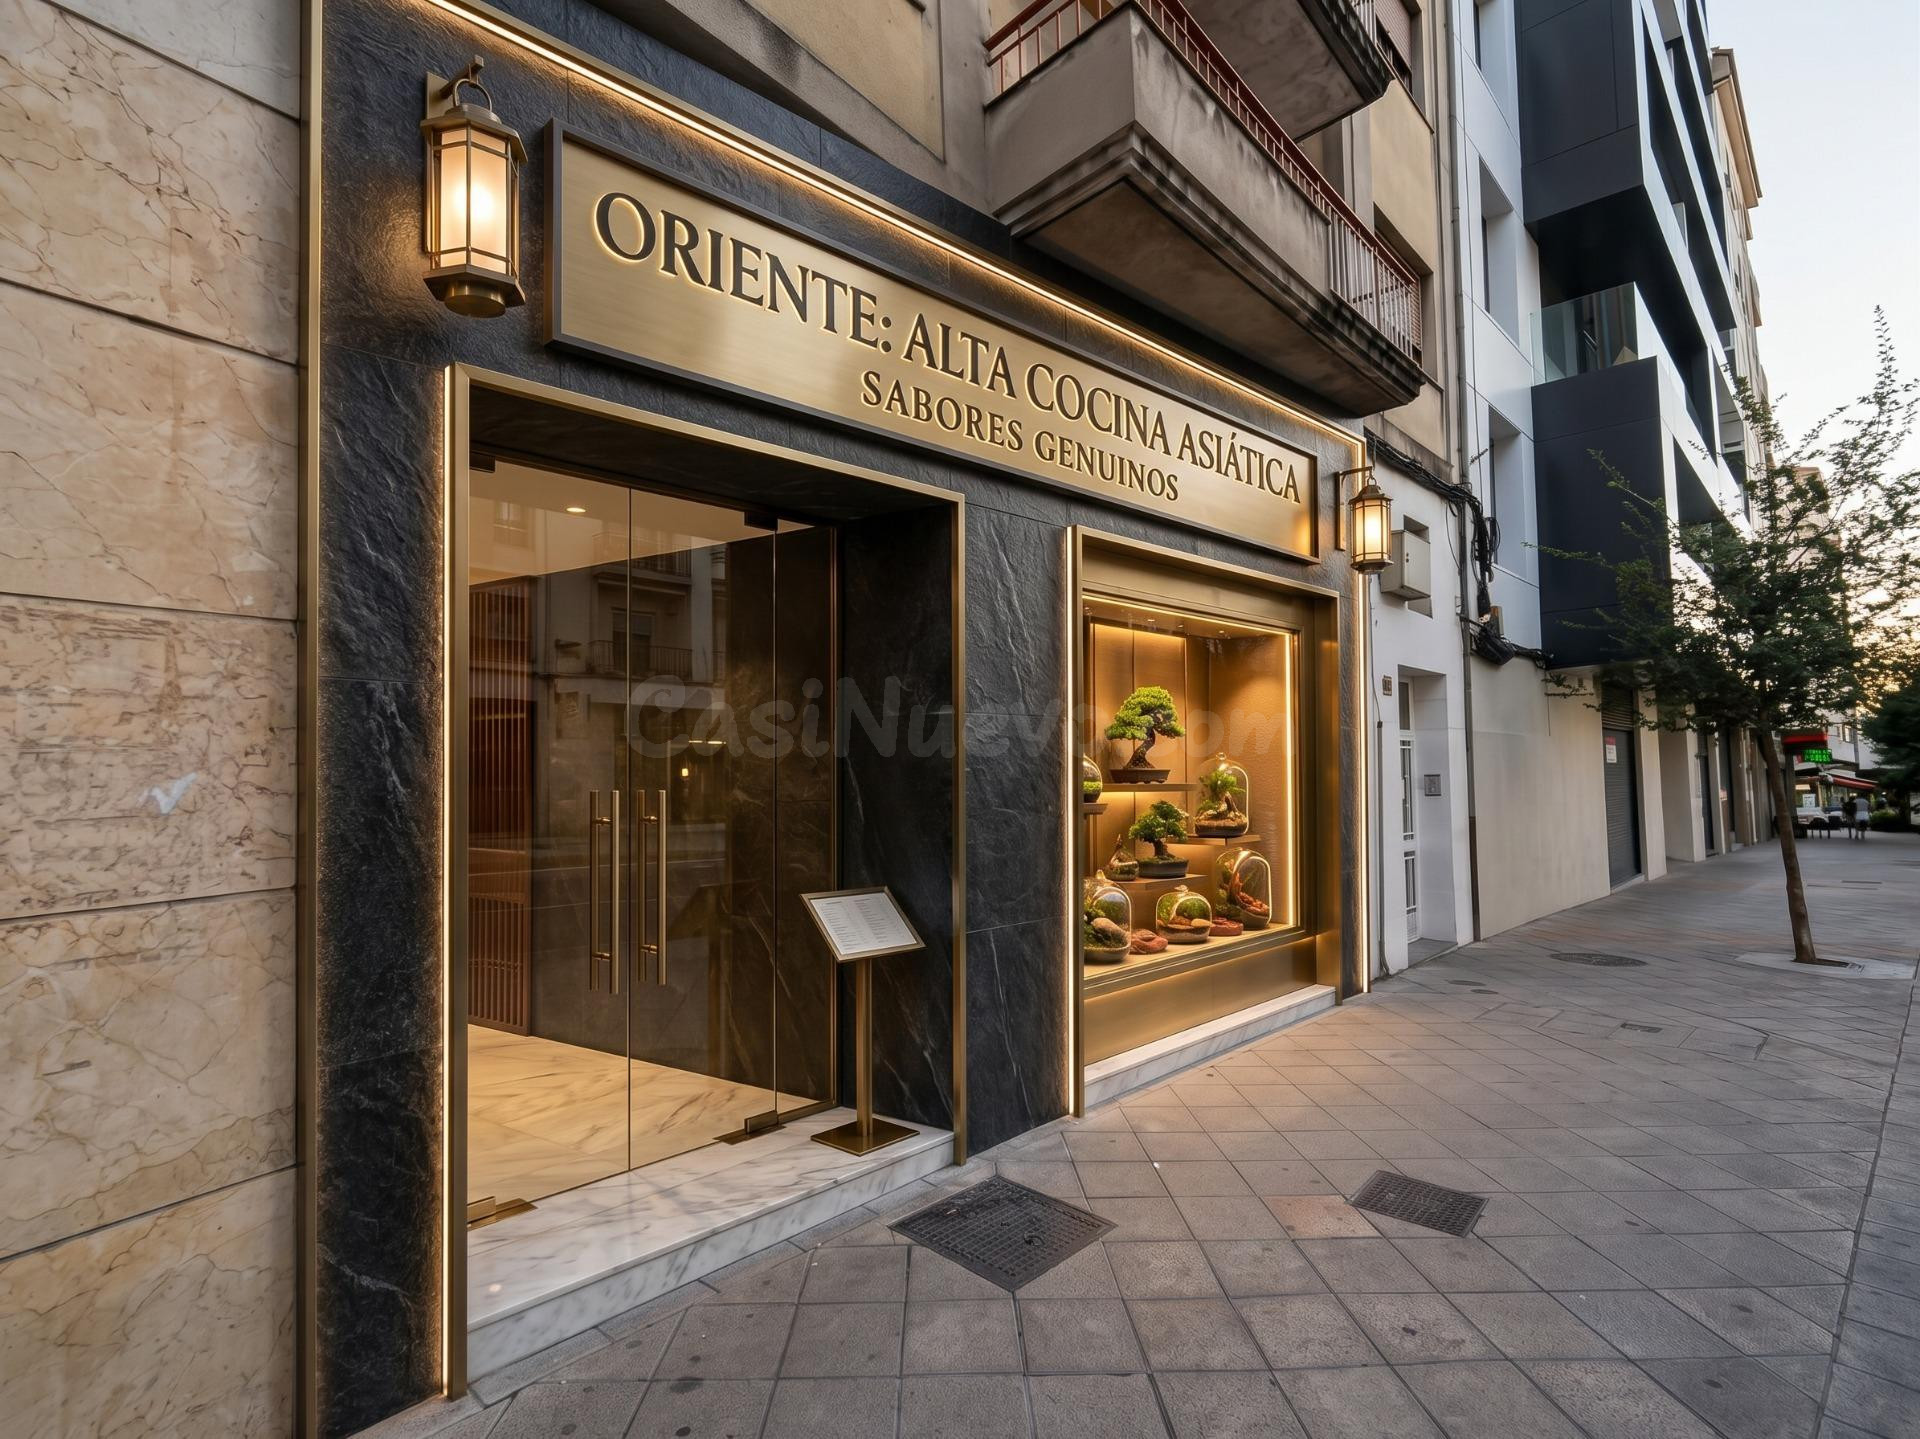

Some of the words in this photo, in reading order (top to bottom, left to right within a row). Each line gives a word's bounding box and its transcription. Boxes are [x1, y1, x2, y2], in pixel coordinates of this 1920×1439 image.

[594, 192, 892, 353] ORIENTE:
[901, 313, 1017, 399] ALTA
[1025, 363, 1172, 456] COCINA
[1177, 422, 1301, 504] ASIÁTICA
[861, 370, 1023, 451] SABORES
[1034, 430, 1179, 501] GENUINOS
